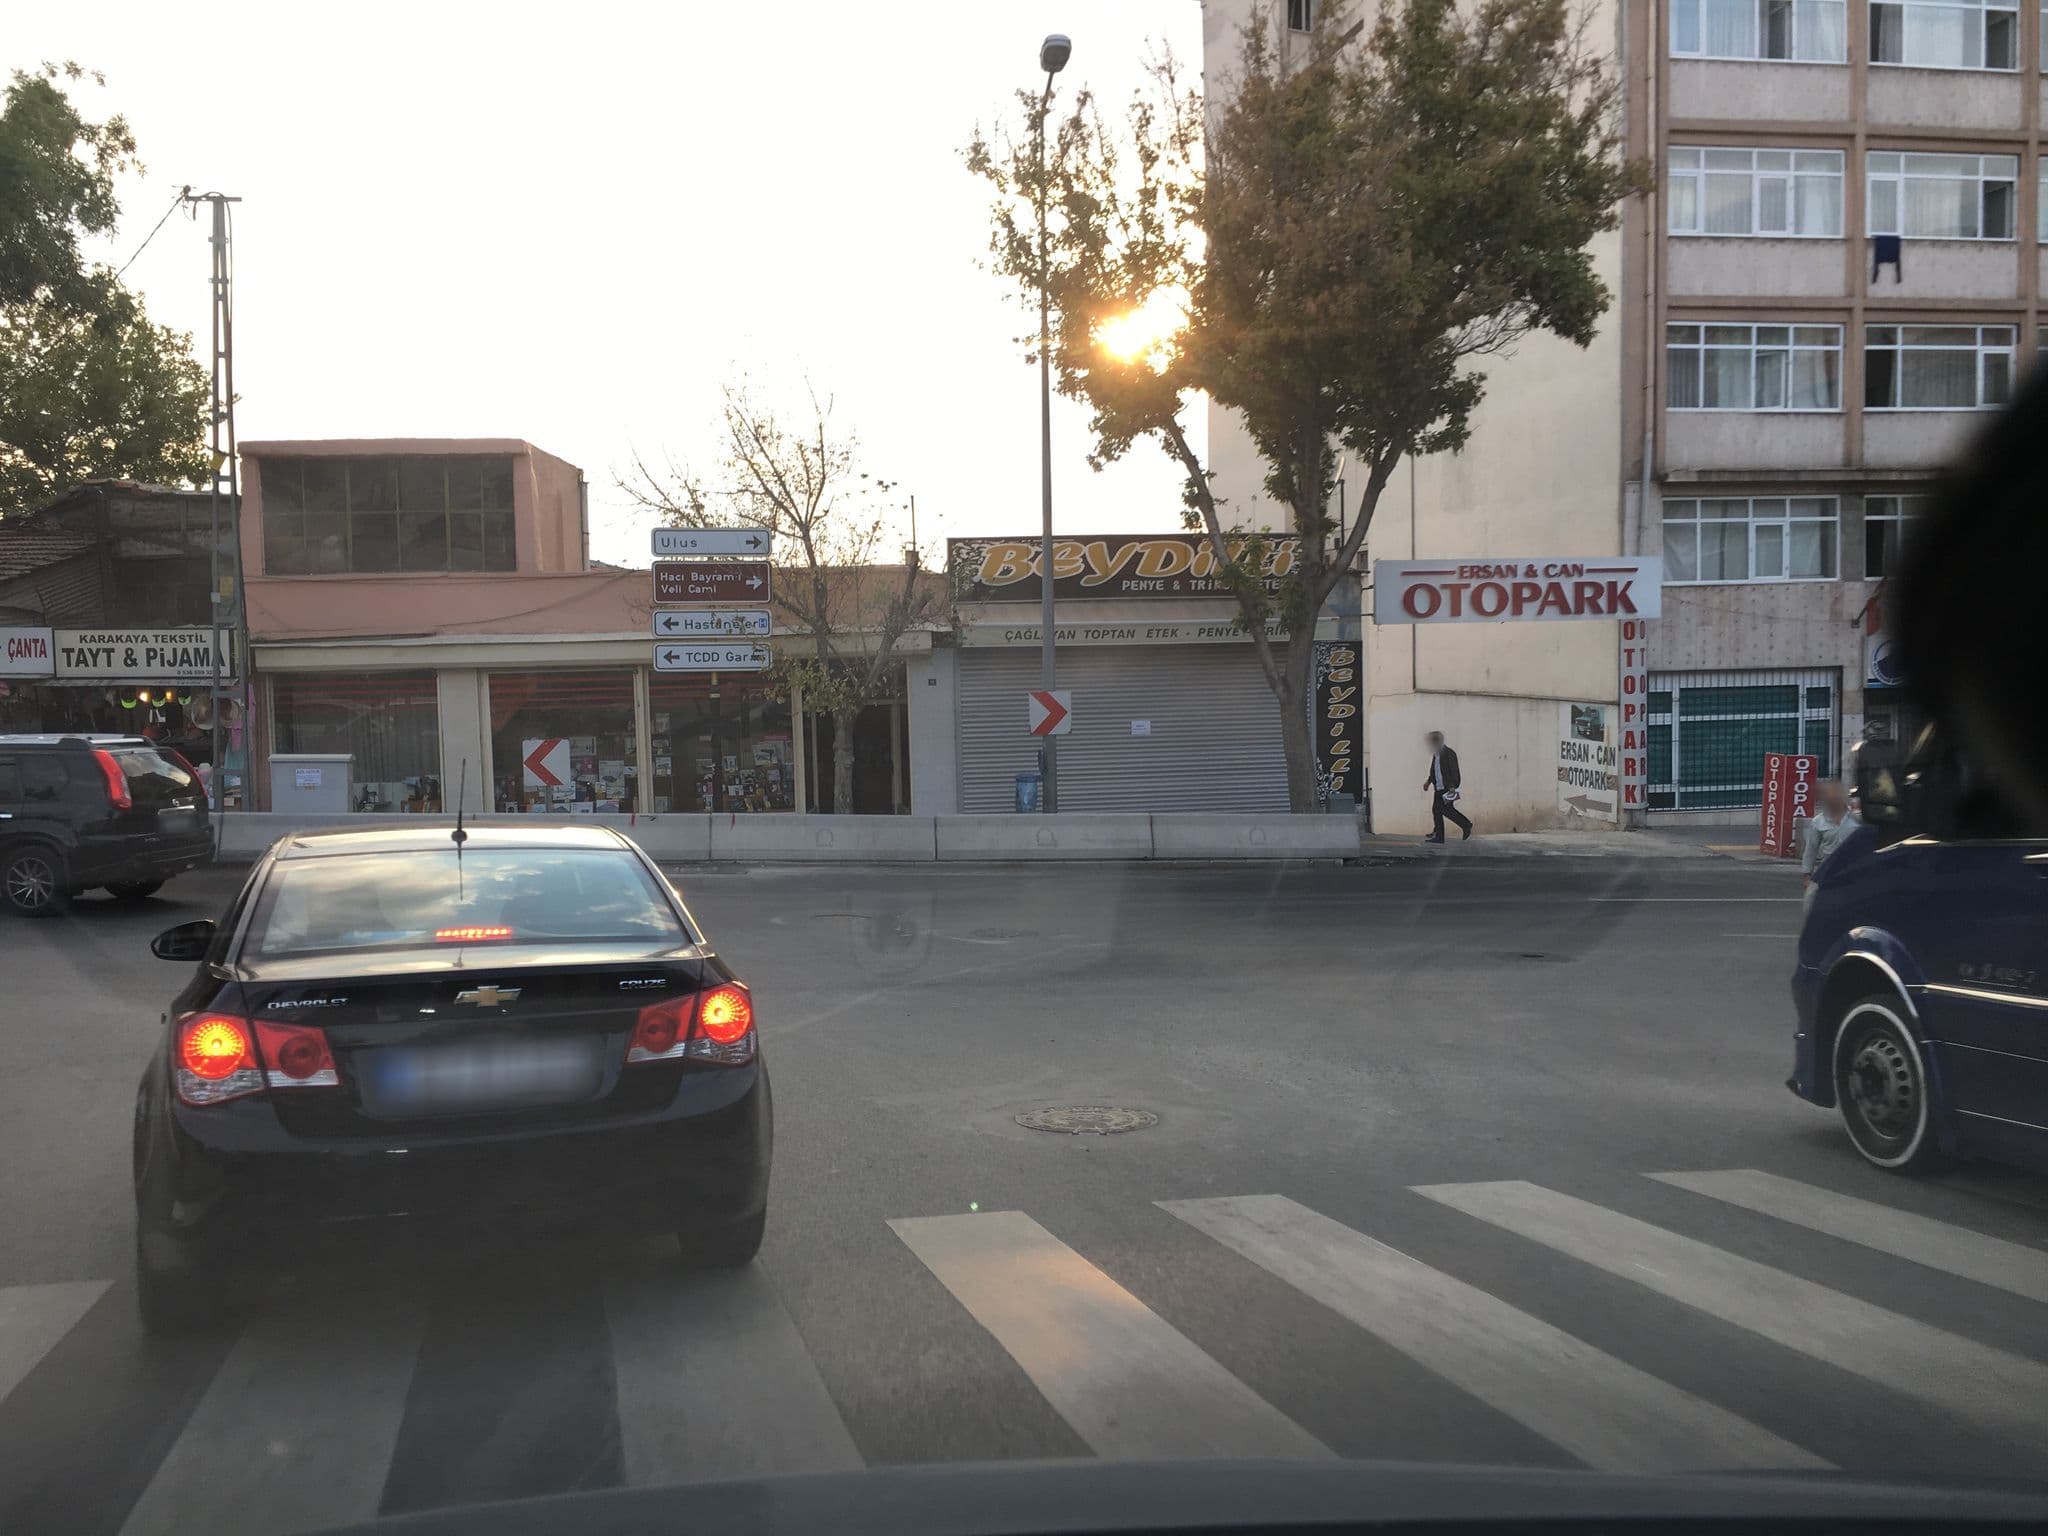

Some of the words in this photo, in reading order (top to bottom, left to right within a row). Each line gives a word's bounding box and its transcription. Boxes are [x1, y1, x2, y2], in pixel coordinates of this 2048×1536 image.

[661, 537, 697, 548] Ulus
[660, 572, 684, 581] Hacı
[1459, 565, 1518, 580] ERSAN
[1524, 563, 1538, 578] &
[1543, 563, 1584, 578] CAN
[1122, 579, 1164, 591] PENYE
[1173, 581, 1180, 590] &
[1402, 579, 1638, 619] OTOPARK
[79, 634, 149, 644] KARAKAYA
[153, 633, 207, 644] TEKSTİL
[1005, 629, 1076, 642] ÇAĞLAN
[1084, 629, 1136, 640] TOPTAN
[1146, 628, 1180, 639] ETEK
[1198, 627, 1240, 638] PENYE
[8, 638, 48, 664] ÇANTA
[62, 648, 115, 668] TAYT
[123, 648, 139, 668] &
[686, 652, 720, 663] TCDD
[725, 652, 748, 662] Gar
[1622, 621, 1638, 804] OTOPARK
[1560, 740, 1590, 763] ERSAN
[1597, 745, 1617, 767] CAN
[1568, 766, 1608, 791] OTOPARK
[1766, 757, 1780, 838] OTOPARK
